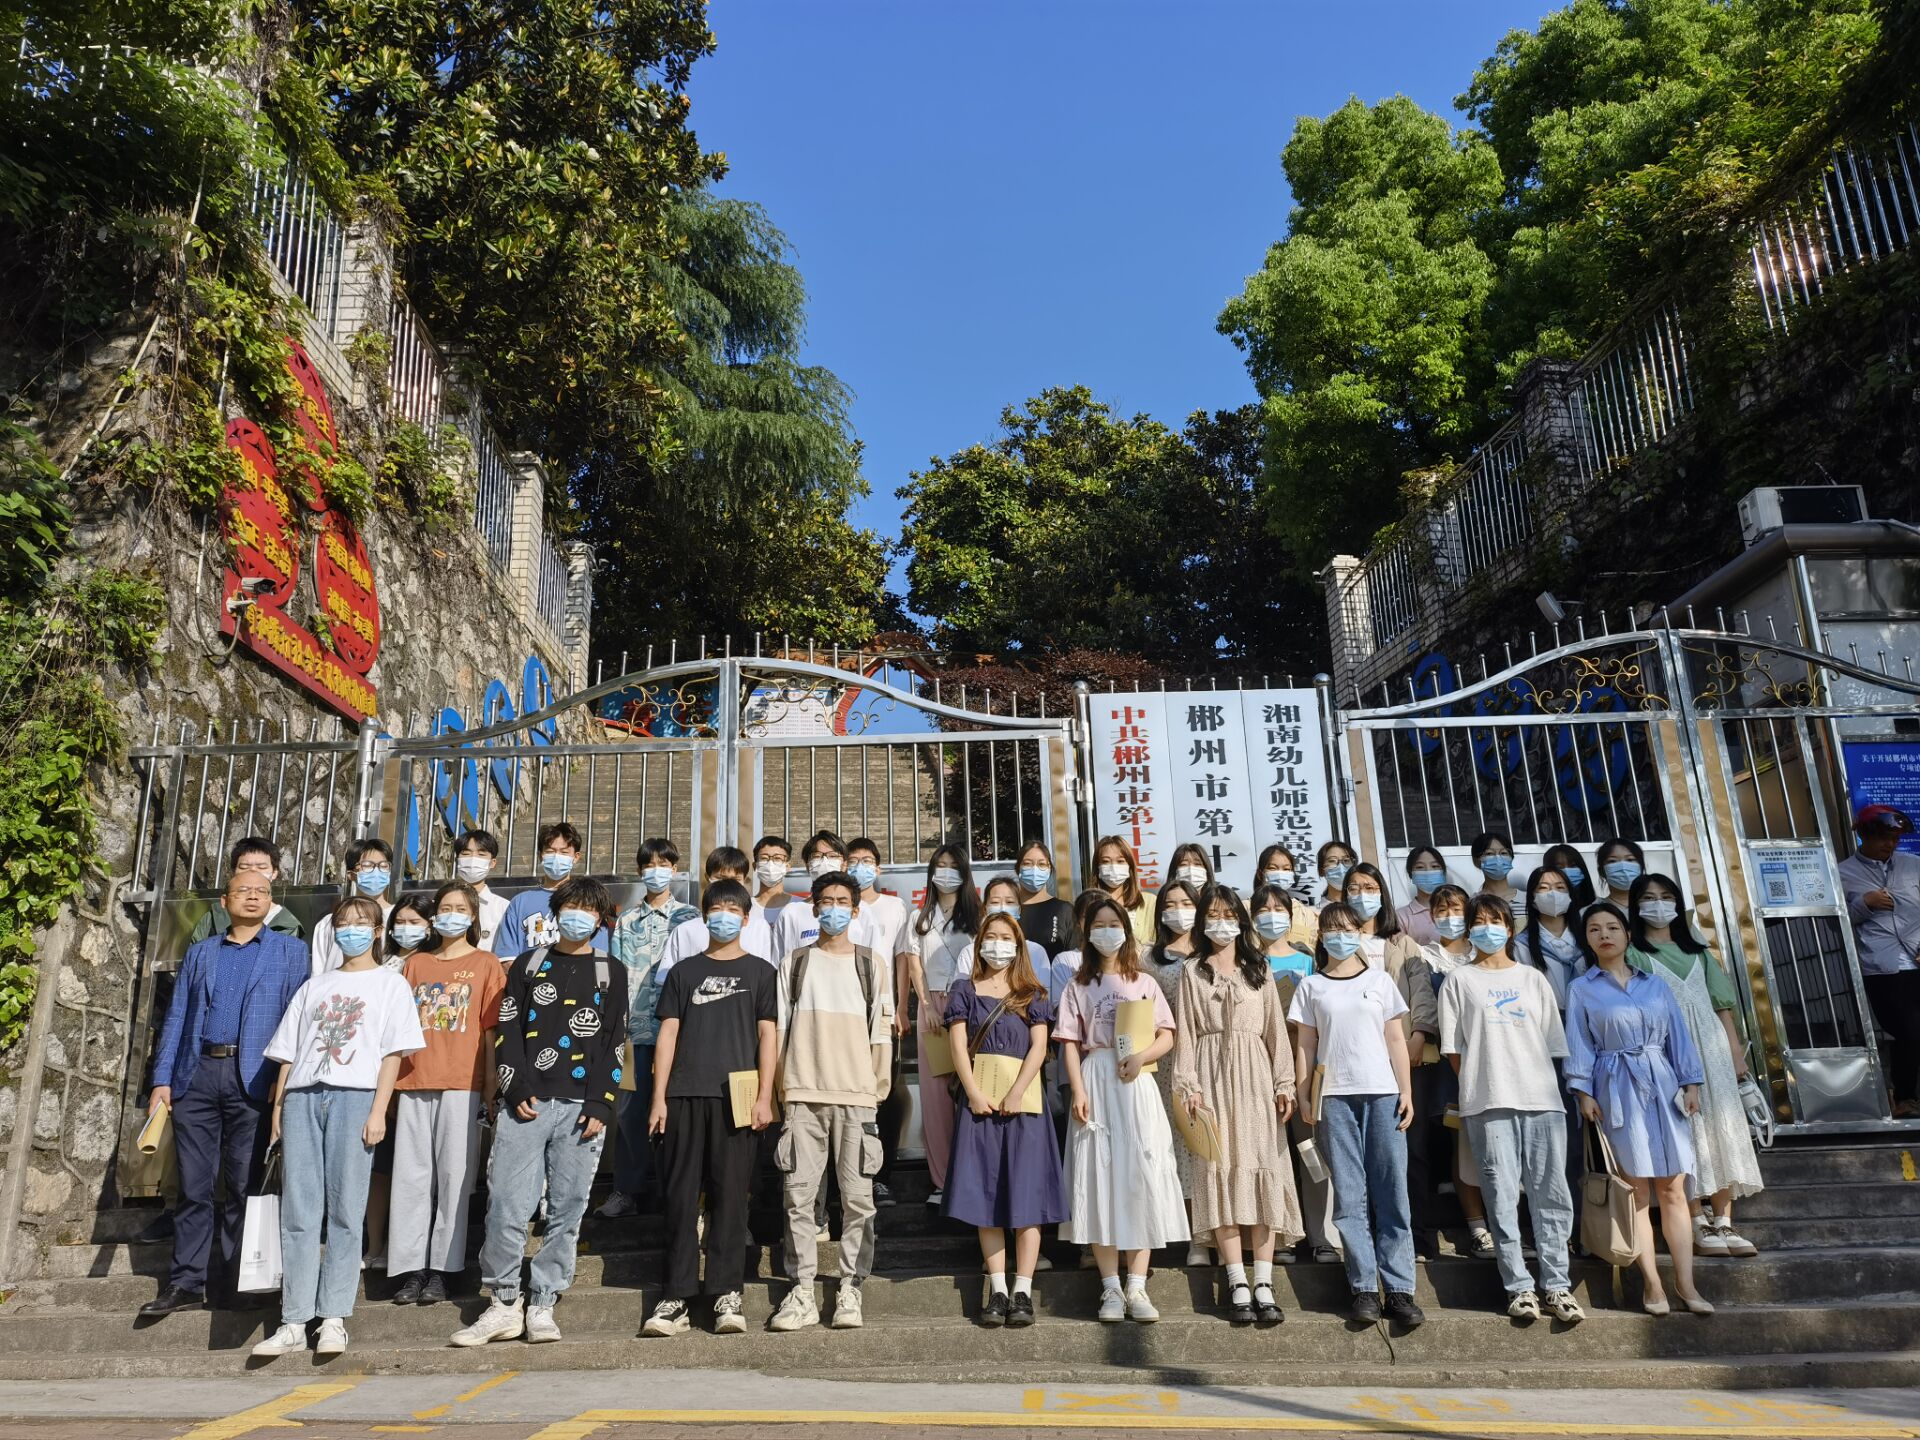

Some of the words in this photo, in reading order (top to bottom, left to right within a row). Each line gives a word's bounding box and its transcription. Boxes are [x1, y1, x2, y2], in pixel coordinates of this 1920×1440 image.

[1186, 704, 1239, 891] 郴州市第十
[1262, 703, 1317, 906] 湘南幼儿师范高等专
[701, 976, 741, 992] NIKE
[1488, 989, 1520, 999] Apple
